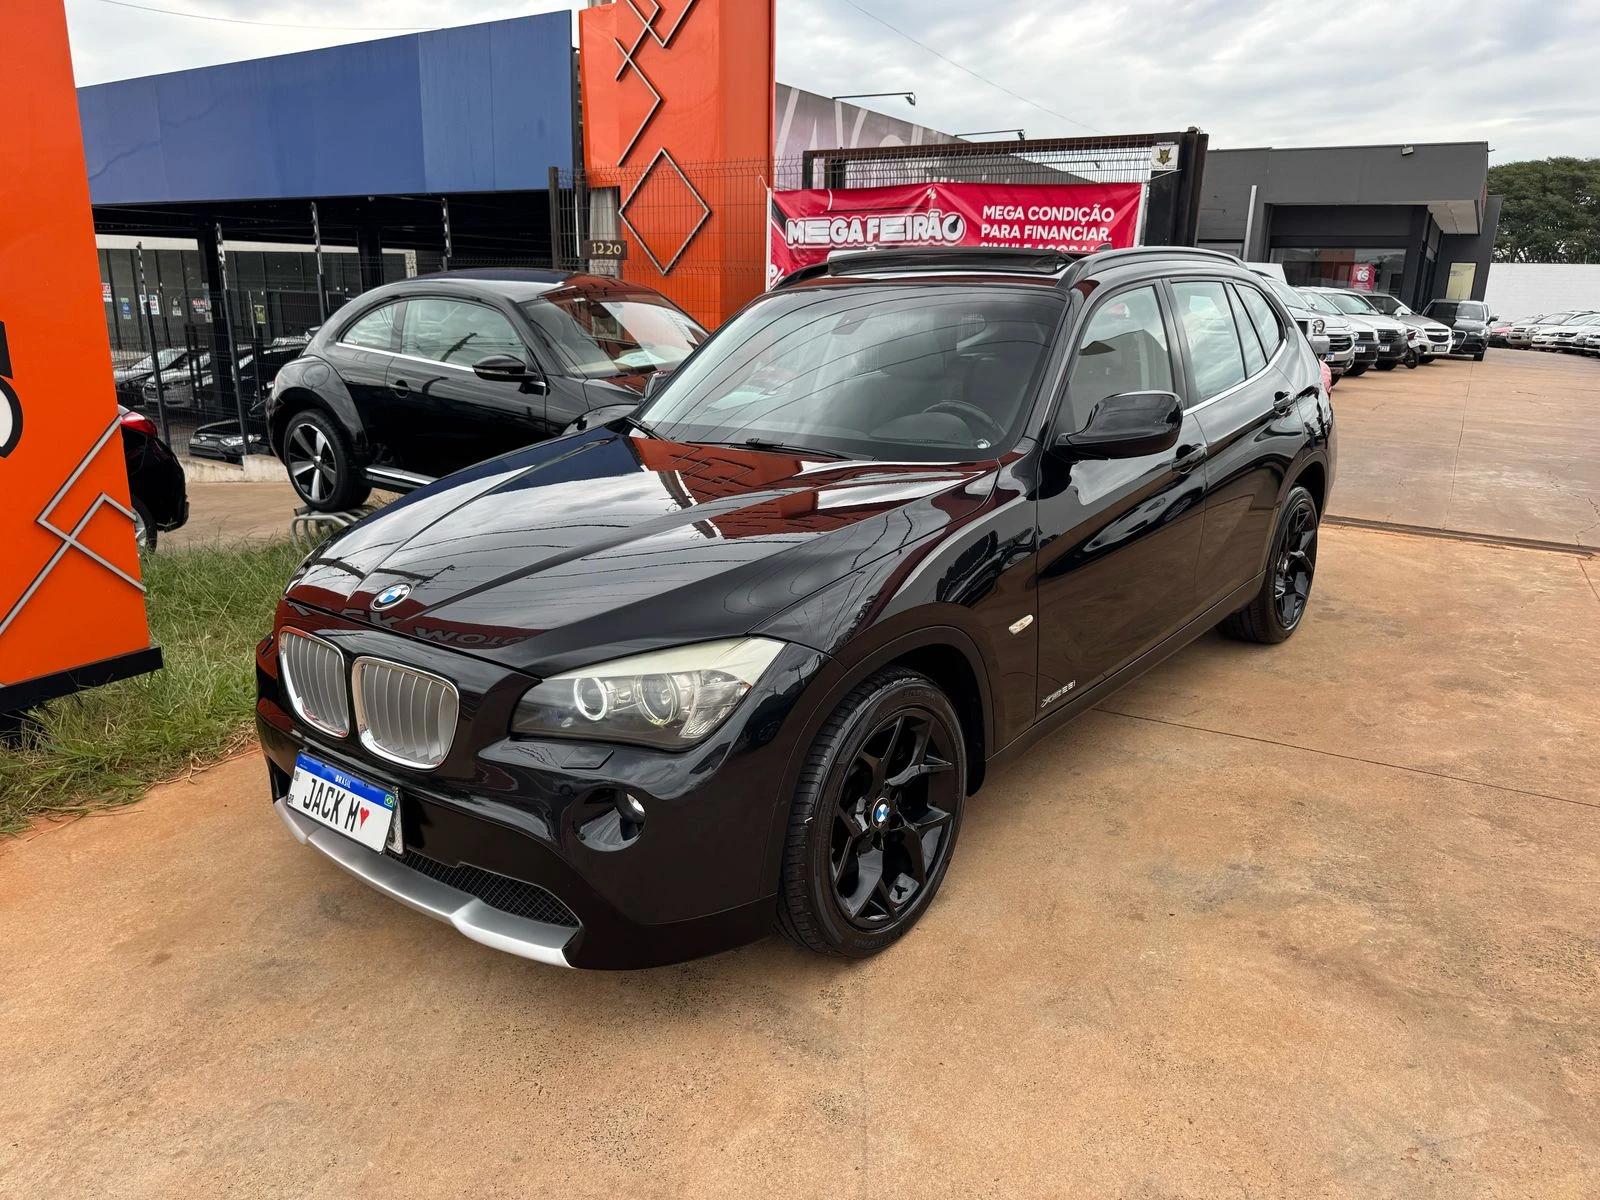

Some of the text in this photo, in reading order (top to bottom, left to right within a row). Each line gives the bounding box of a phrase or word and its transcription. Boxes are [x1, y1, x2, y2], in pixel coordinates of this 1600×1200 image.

[982, 203, 1115, 226] MEGA CONDIÇÃO
[980, 224, 1112, 242] PARA FINANCIAR.
[592, 242, 622, 255] 1220
[302, 778, 361, 833] JACK M
